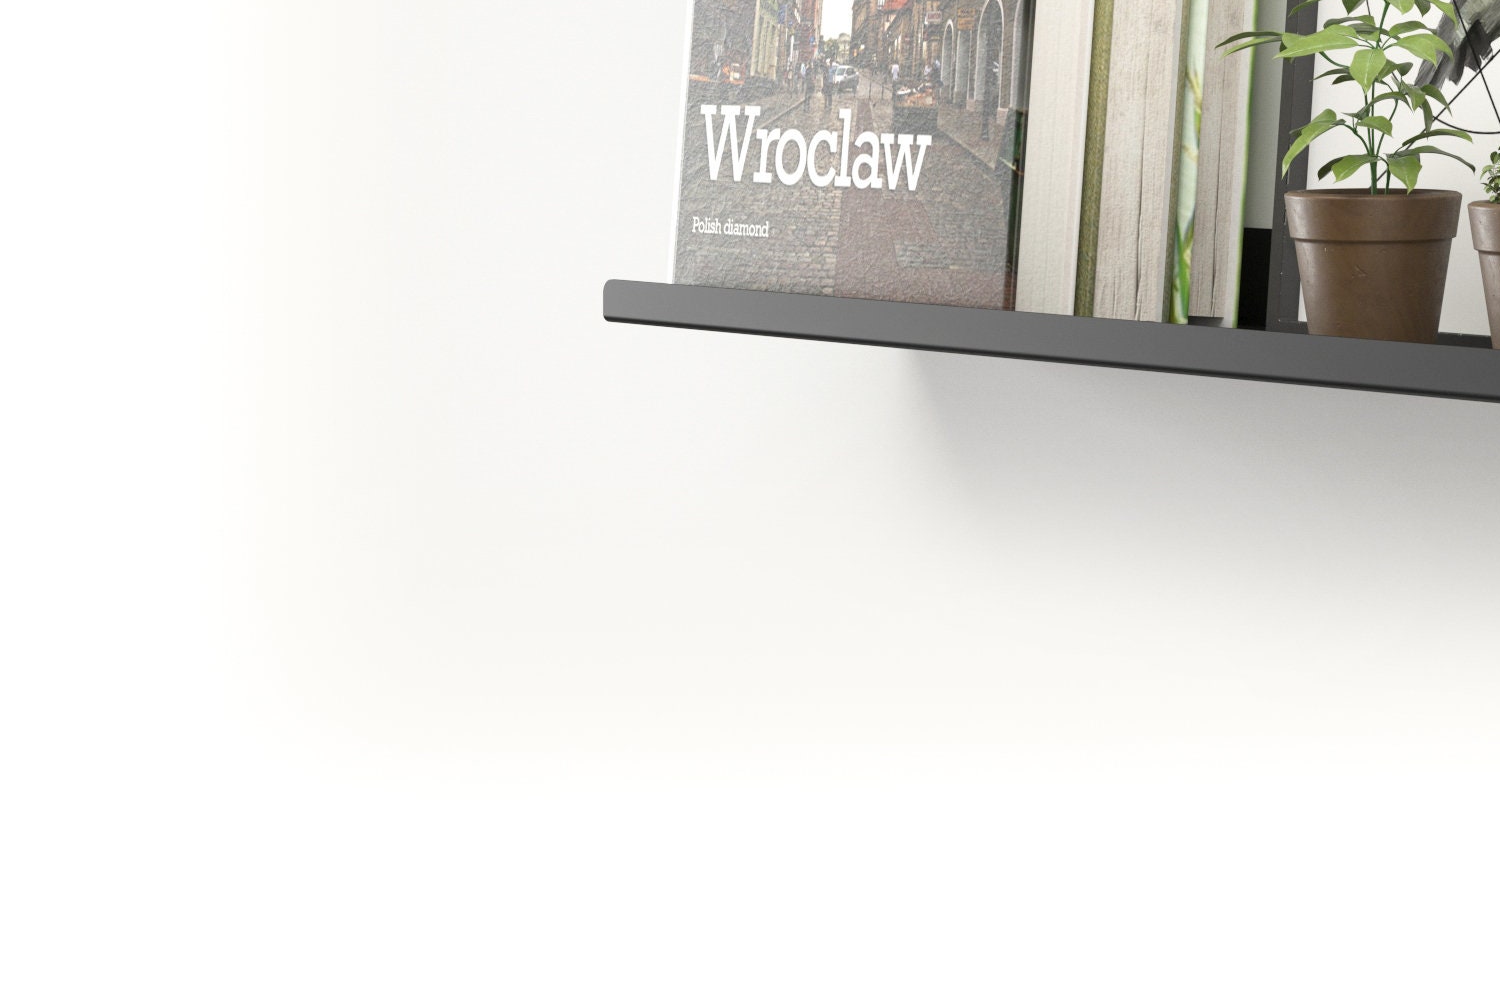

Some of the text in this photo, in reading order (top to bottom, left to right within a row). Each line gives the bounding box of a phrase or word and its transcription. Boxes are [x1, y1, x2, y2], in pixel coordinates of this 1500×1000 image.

[701, 104, 932, 191] Wroclaw
[692, 216, 769, 238] Polish diamond
